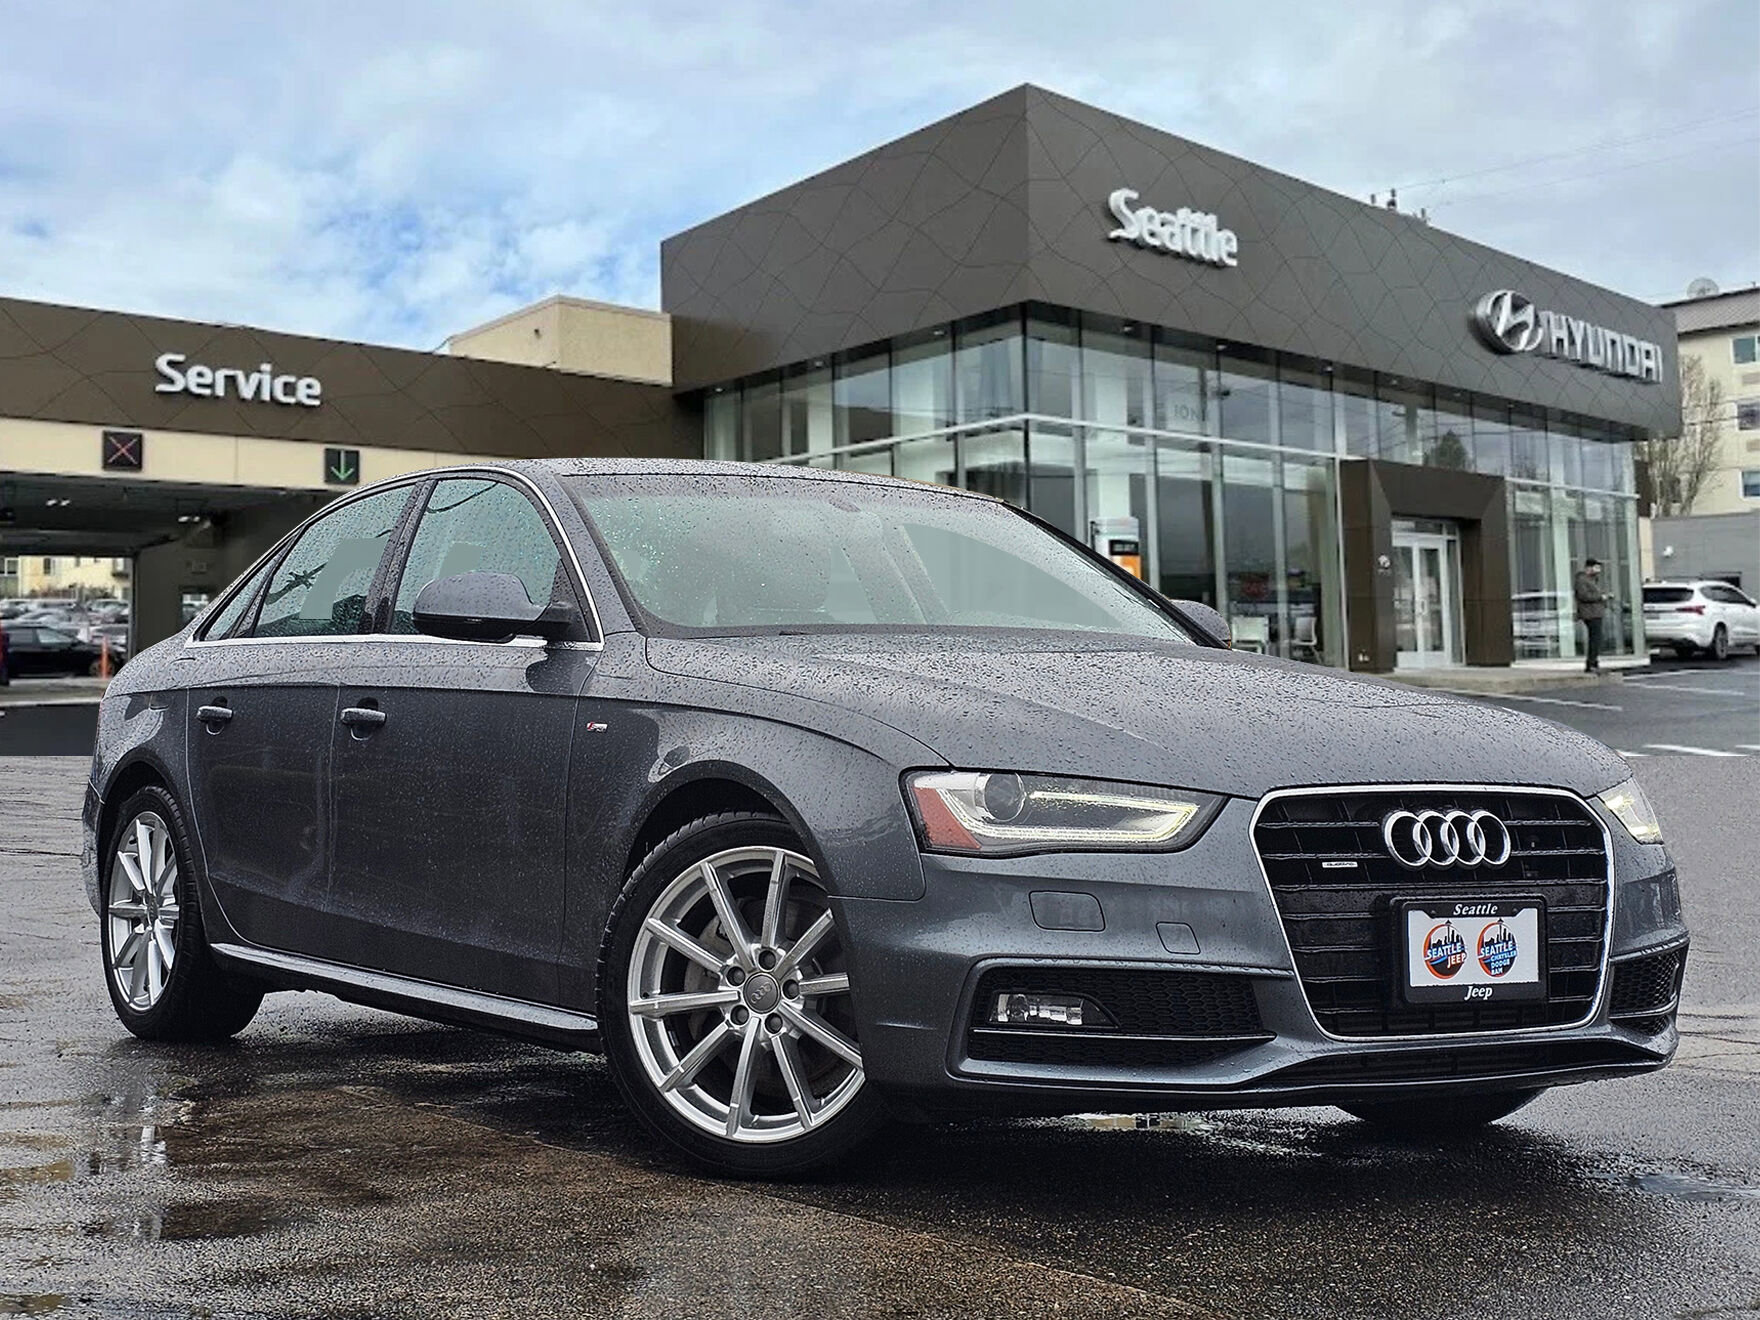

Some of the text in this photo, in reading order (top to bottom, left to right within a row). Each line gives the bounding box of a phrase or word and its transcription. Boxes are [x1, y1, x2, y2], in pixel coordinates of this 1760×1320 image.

[1108, 188, 1238, 267] Seattle
[1542, 310, 1663, 383] HYUNDAI
[155, 353, 321, 406] Service
[1453, 904, 1498, 916] Seattle
[1426, 943, 1462, 960] SEATTLE
[1480, 941, 1513, 957] SEATTLE
[1447, 952, 1467, 968] JEEP
[1491, 959, 1510, 969] DODGE
[1464, 986, 1493, 1000] Jeep
